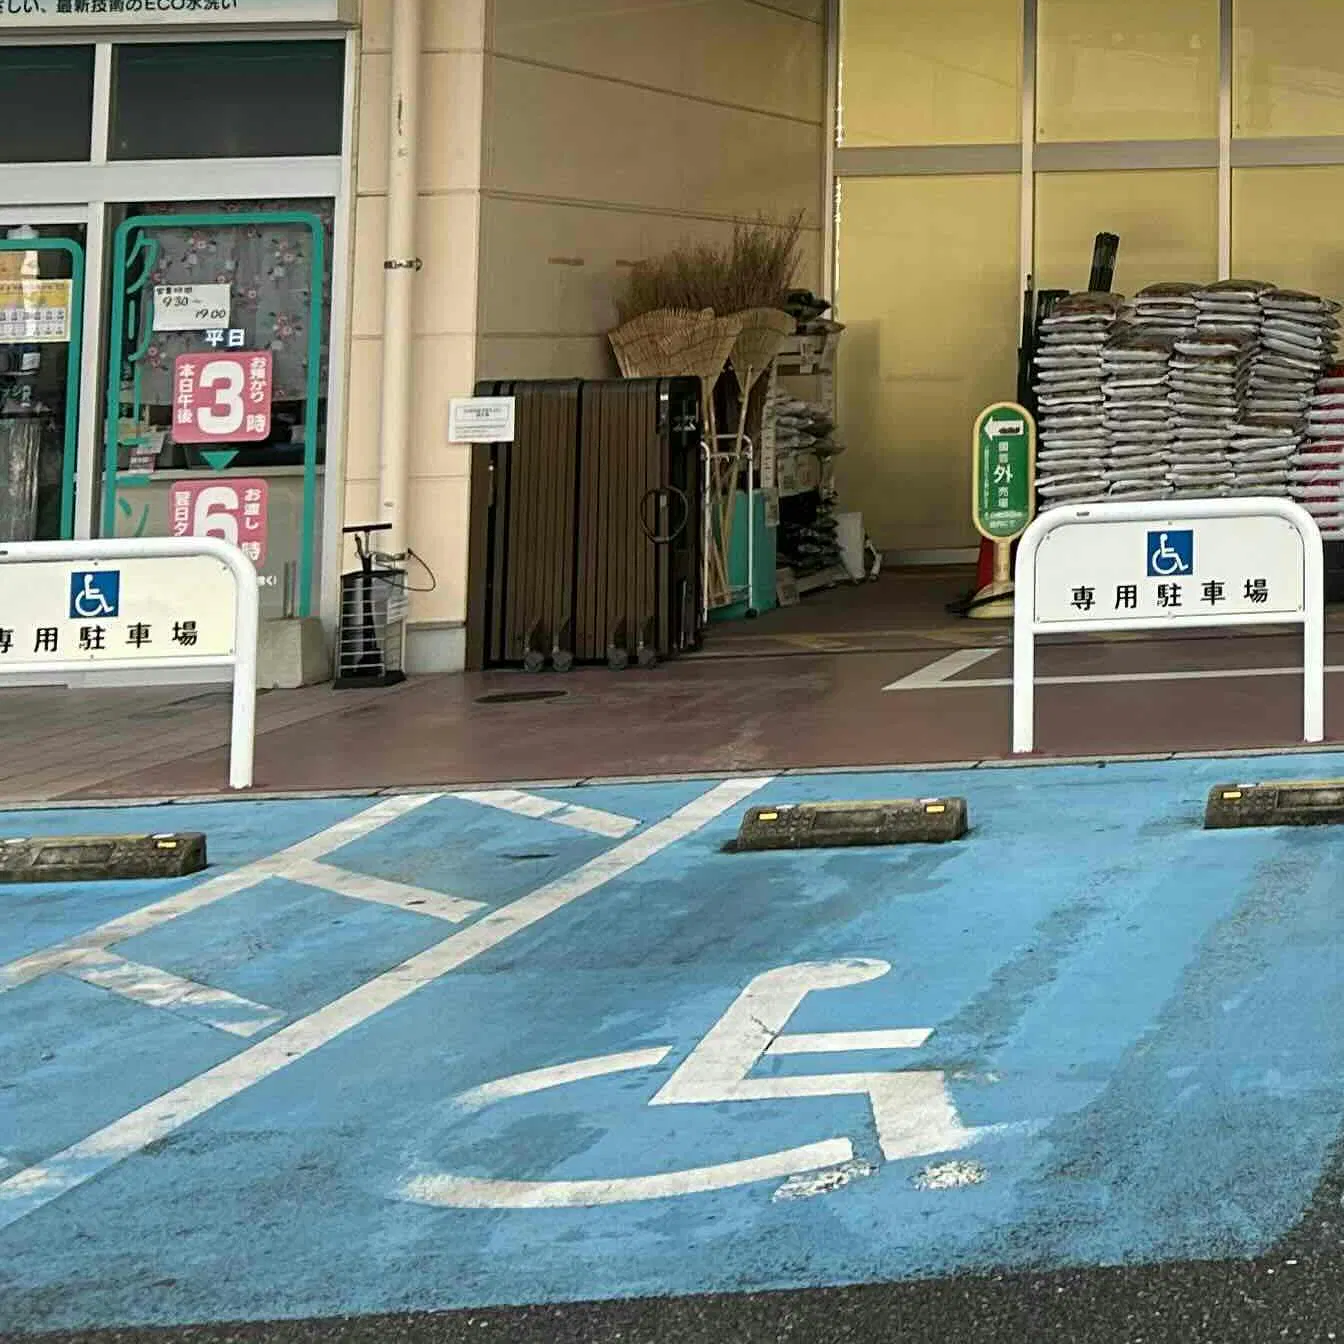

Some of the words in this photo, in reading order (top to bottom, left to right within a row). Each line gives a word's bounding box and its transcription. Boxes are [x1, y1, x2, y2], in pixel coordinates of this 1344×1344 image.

[205, 328, 245, 347] 平日
[177, 363, 196, 425] 本日午後
[197, 360, 244, 435] 3
[245, 414, 266, 434] 時
[1070, 578, 1269, 611] 専用駐車場
